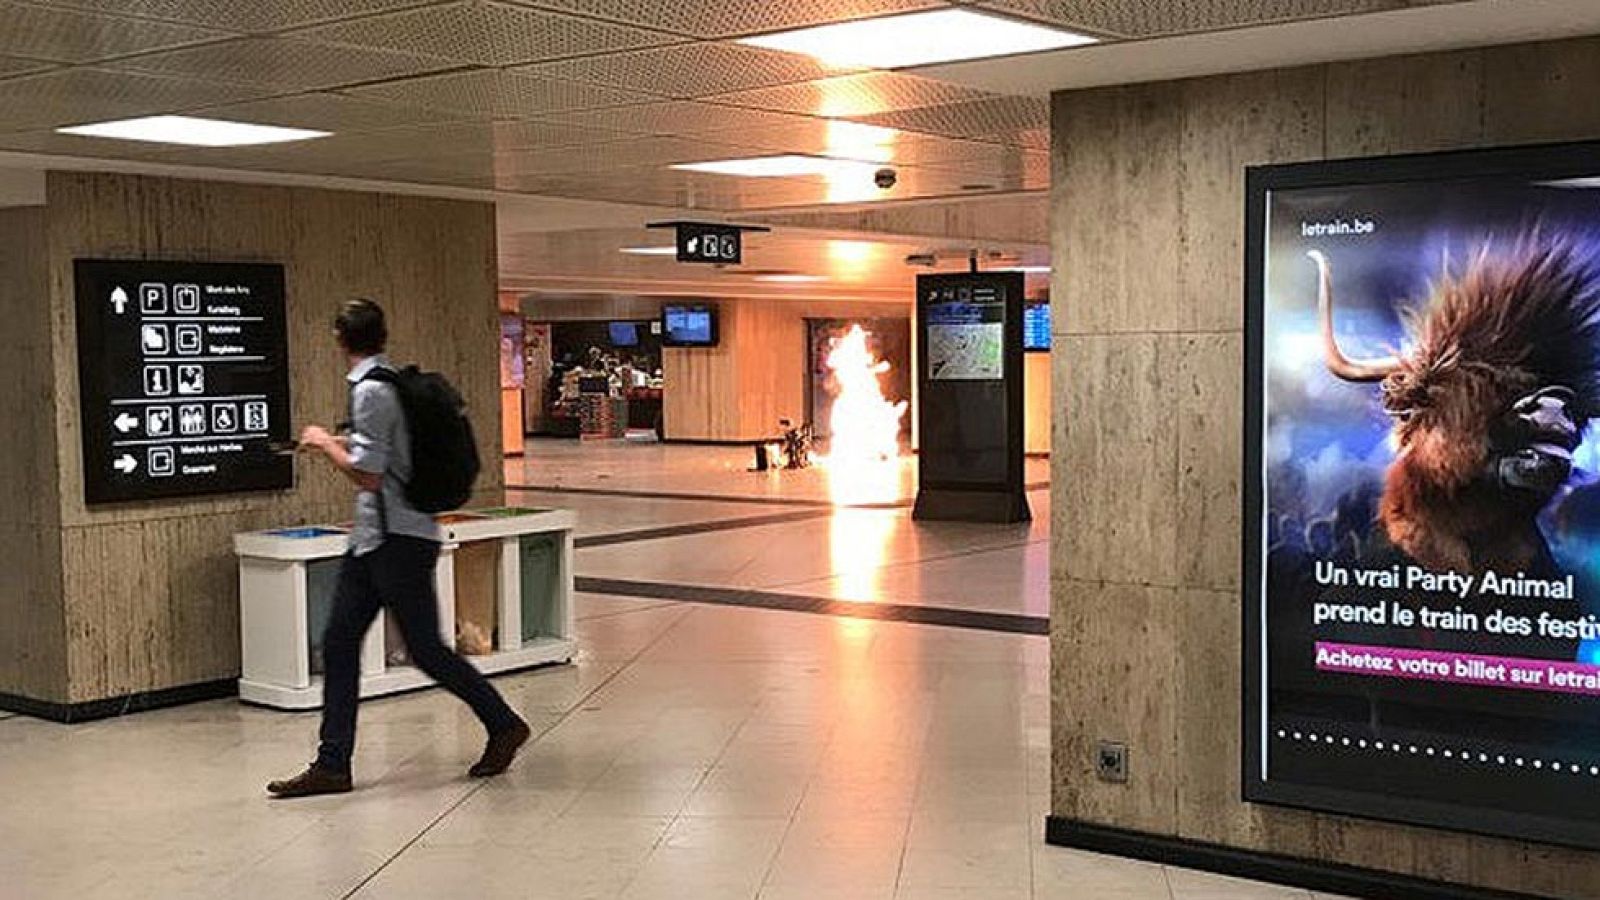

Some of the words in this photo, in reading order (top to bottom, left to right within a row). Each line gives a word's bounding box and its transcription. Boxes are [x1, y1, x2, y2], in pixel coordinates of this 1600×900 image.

[1302, 218, 1375, 237] letrain.be
[1315, 561, 1348, 586] Un
[1354, 564, 1400, 588] vrai
[1406, 565, 1474, 599] Party
[1480, 570, 1575, 599] Animal
[1313, 600, 1387, 625] prend
[1392, 602, 1415, 626] le
[1419, 605, 1479, 632] train
[1484, 609, 1532, 636] des
[1316, 647, 1394, 671] Achetez
[1397, 657, 1450, 676] votre
[1455, 659, 1506, 681] billet
[1510, 668, 1543, 684] sur
